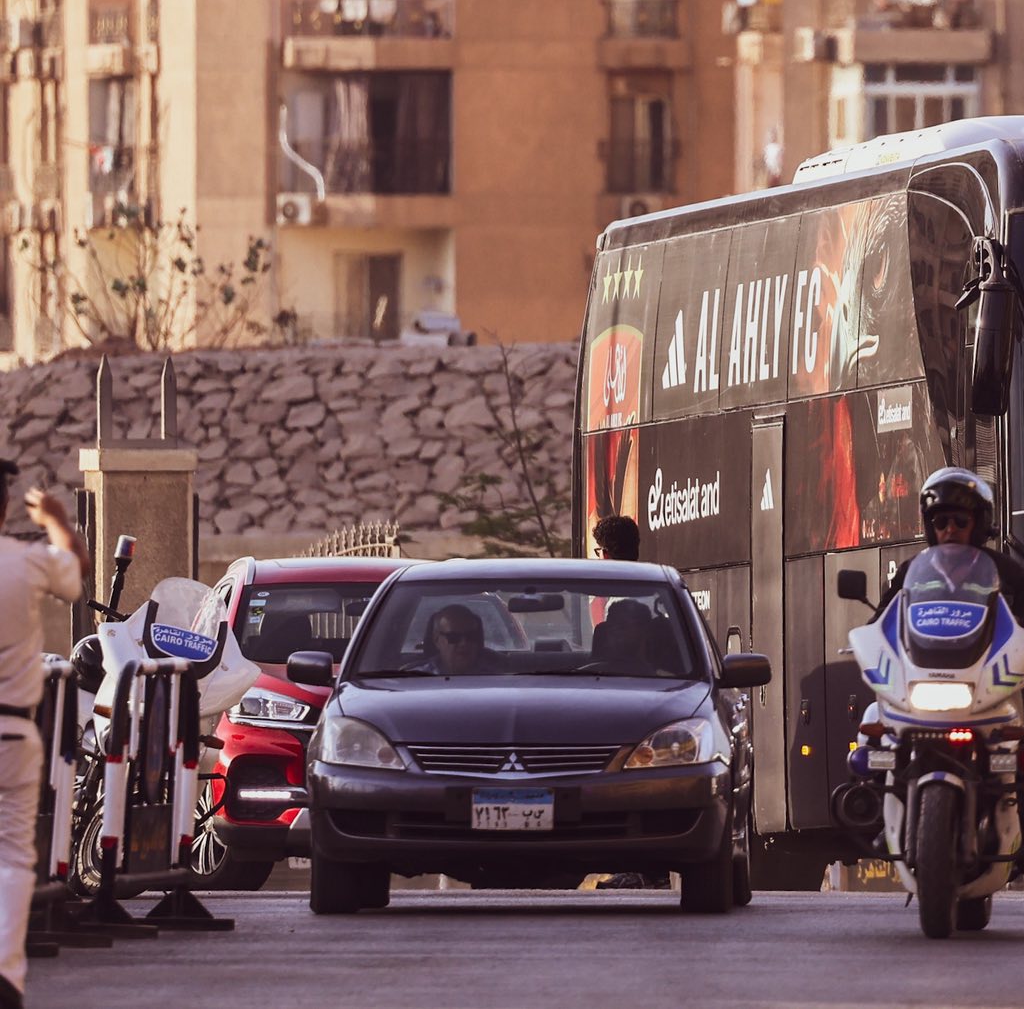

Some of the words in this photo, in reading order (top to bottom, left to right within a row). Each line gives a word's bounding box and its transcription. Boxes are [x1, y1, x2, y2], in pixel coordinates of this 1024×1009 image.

[693, 288, 720, 393] AL
[728, 274, 788, 388] AHLY
[792, 266, 822, 375] FC
[665, 477, 700, 527] etisalat
[701, 470, 720, 518] and
[917, 606, 949, 618] القاهرة
[950, 609, 973, 618] مرور
[916, 618, 940, 628] CAIRO
[941, 617, 971, 628] TRAFFIC
[154, 633, 183, 646] CAIRO
[184, 639, 213, 655] TRAFFIC
[187, 634, 213, 646] مرور
